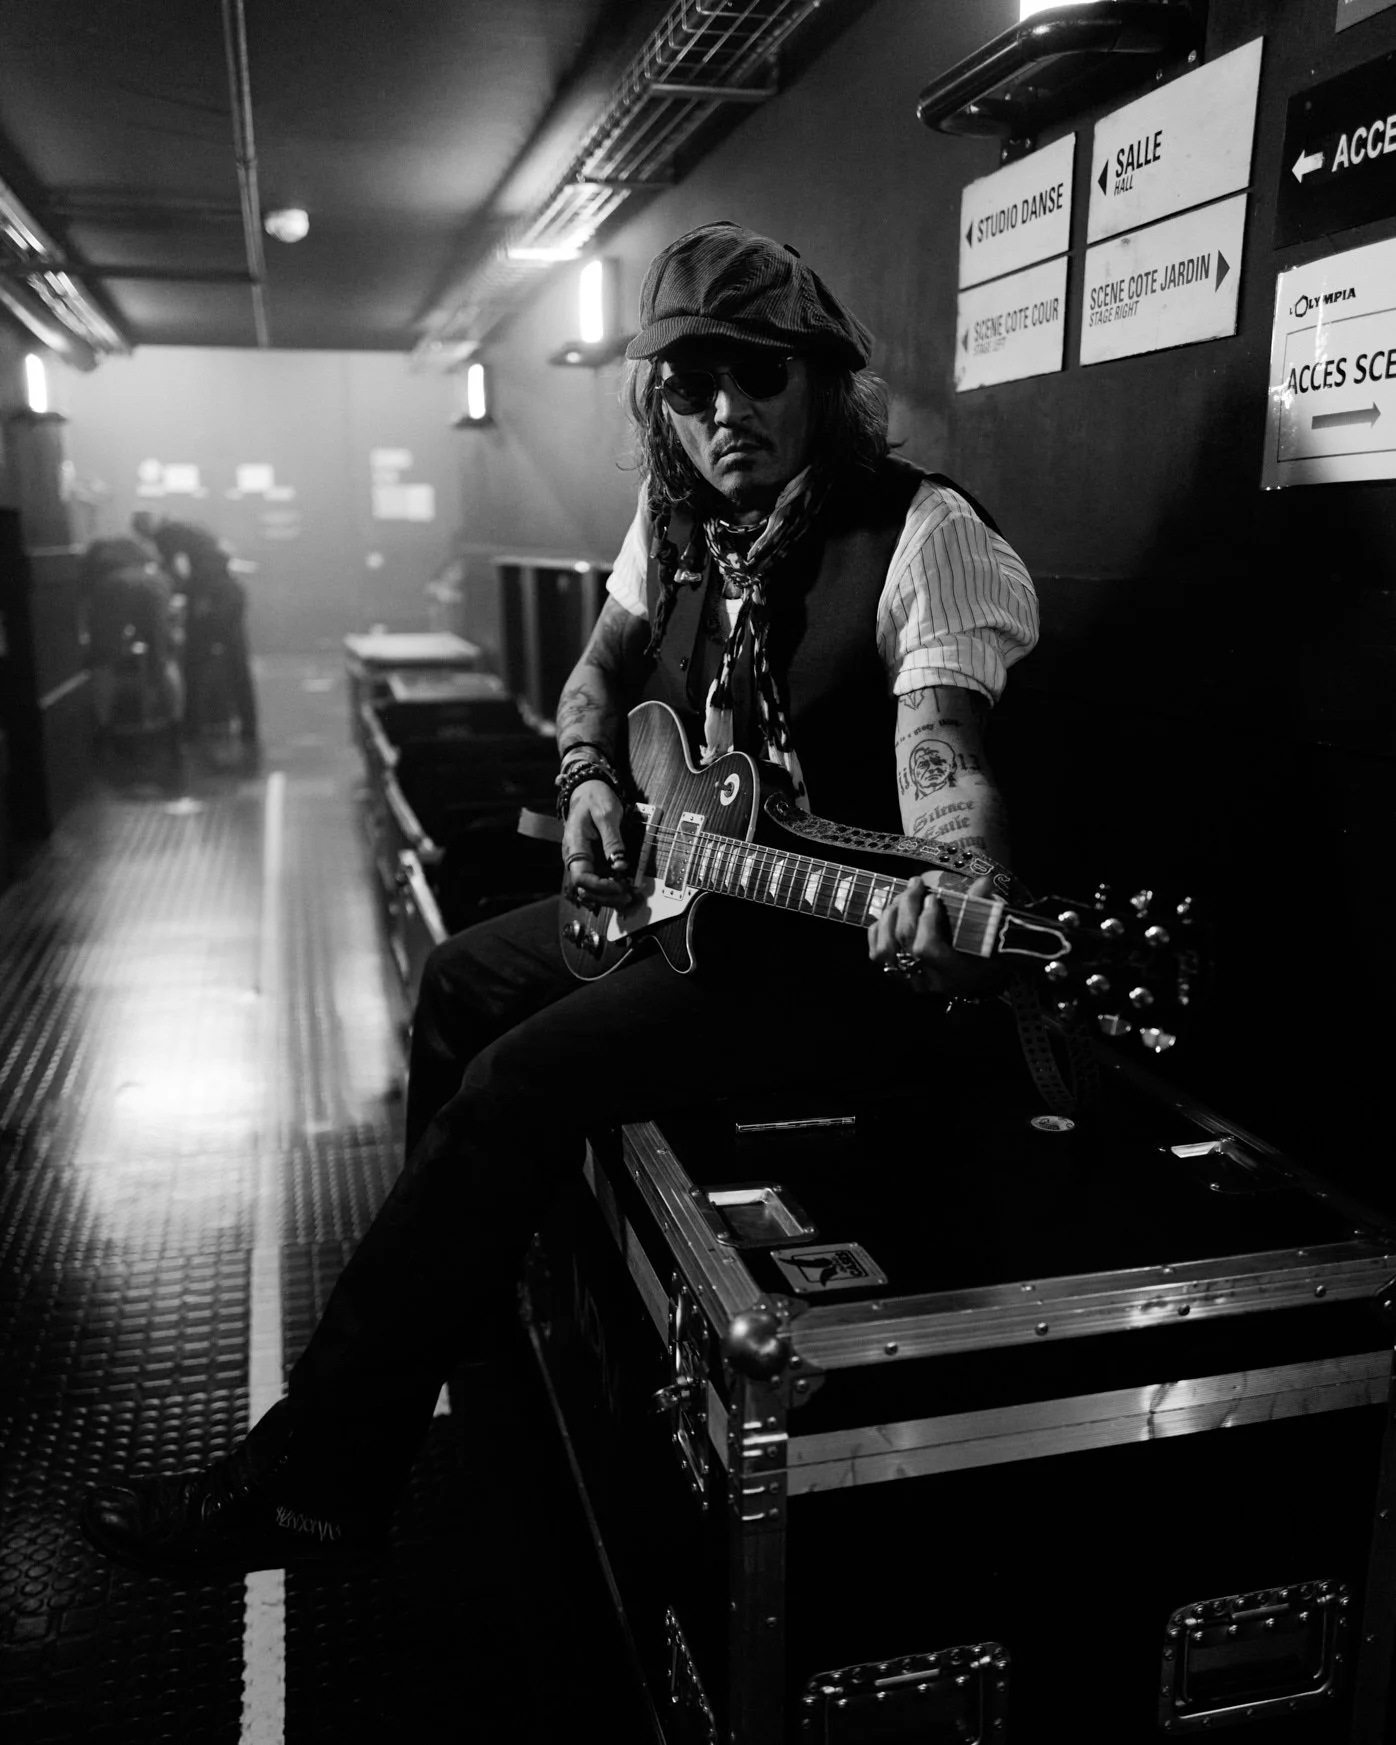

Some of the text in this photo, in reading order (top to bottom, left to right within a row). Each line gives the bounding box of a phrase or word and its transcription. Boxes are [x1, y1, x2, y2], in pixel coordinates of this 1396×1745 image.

[1115, 130, 1163, 178] SALLE
[1114, 174, 1134, 196] HALL
[977, 183, 1064, 243] STUDIO DANSE
[1090, 253, 1211, 311] SCENE COTE JARDIN
[974, 297, 1060, 342] SCENE COTE COUR
[1089, 300, 1140, 327] STAGE RIGHT
[1288, 357, 1347, 395] ACCES
